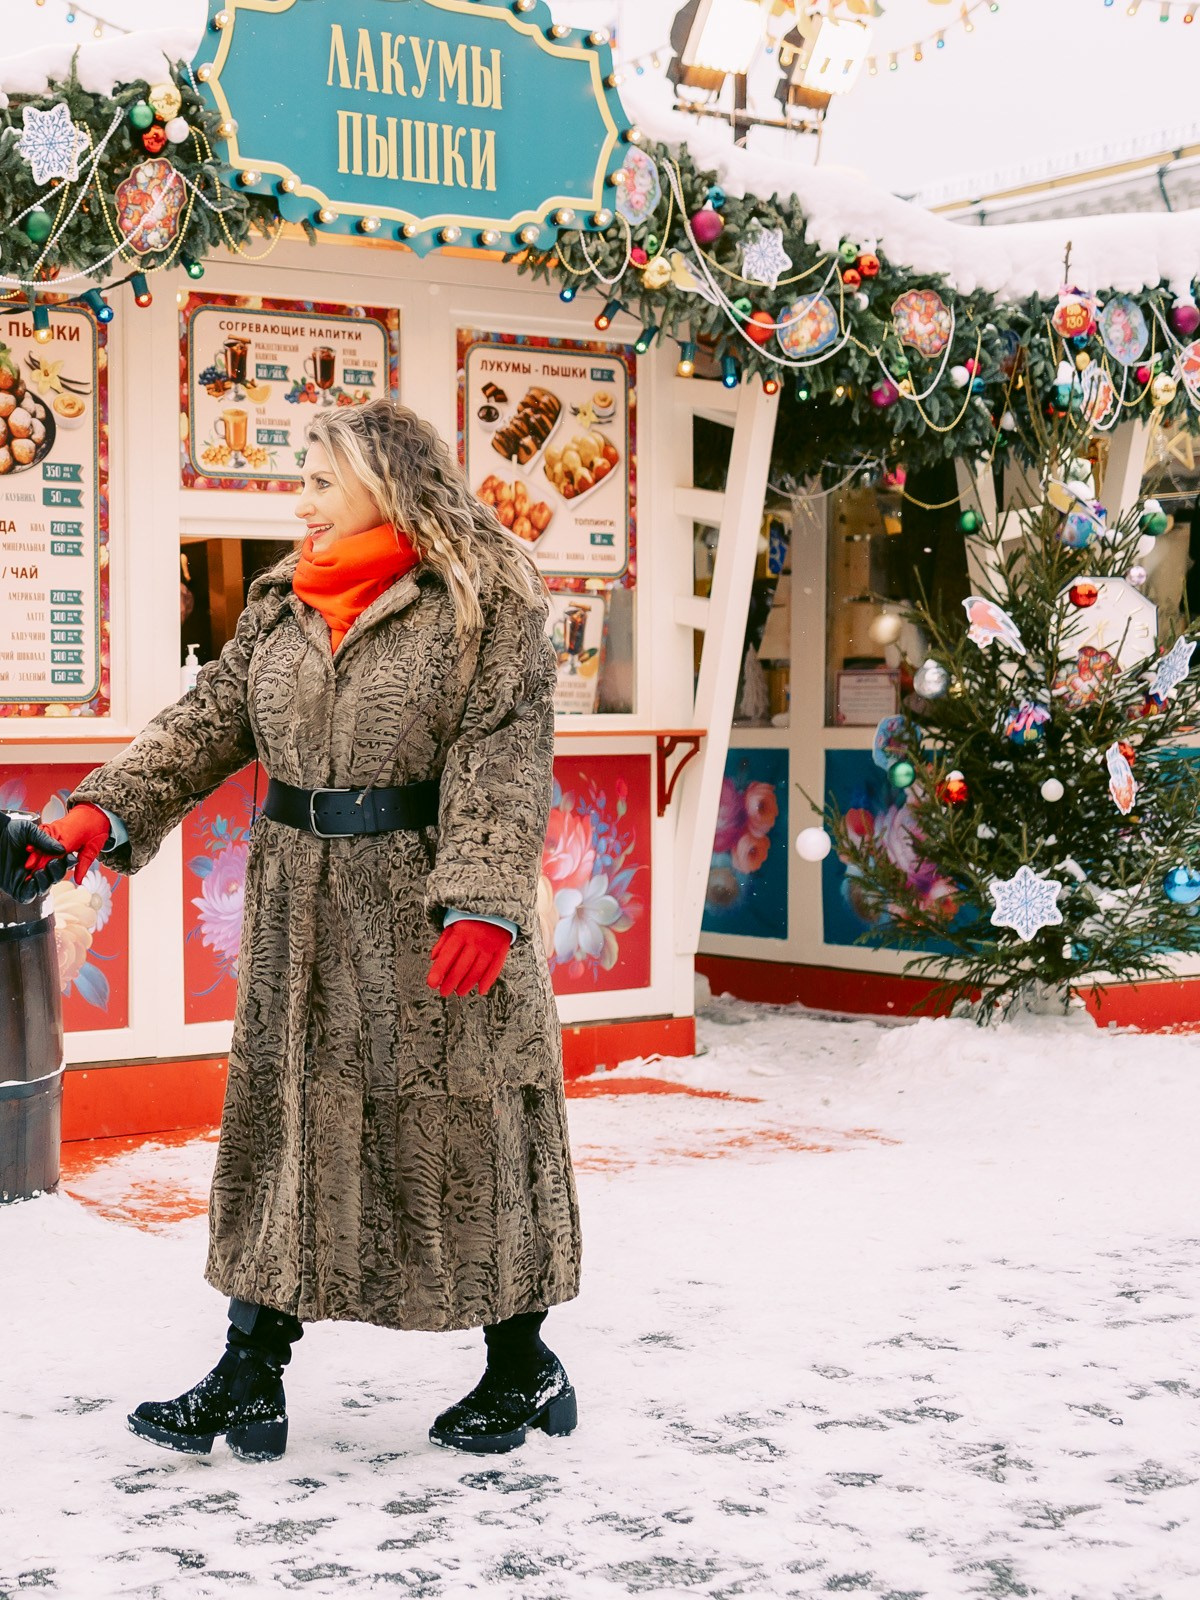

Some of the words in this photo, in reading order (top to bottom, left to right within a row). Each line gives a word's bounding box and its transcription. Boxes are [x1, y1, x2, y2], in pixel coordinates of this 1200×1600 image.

[326, 23, 503, 110] ЛАКУМЫ
[336, 109, 497, 191] ПЫШКИ
[9, 321, 80, 342] ПЫКИ
[218, 320, 306, 337] СОГРЕВАЮЩИЕ
[309, 327, 362, 341] НАПИТКИ
[480, 359, 532, 374] ЛУКУМЫ
[542, 364, 587, 379] ПЫШКИ
[46, 465, 61, 478] 350
[50, 490, 62, 503] 50
[30, 523, 46, 532] КОЛА
[52, 523, 66, 534] 200
[2, 542, 46, 552] МИНЕРАЛЬНАЯ
[53, 542, 66, 553] 150
[10, 564, 39, 579] ЧАЙ
[52, 591, 66, 602] 200
[54, 671, 67, 682] 150
